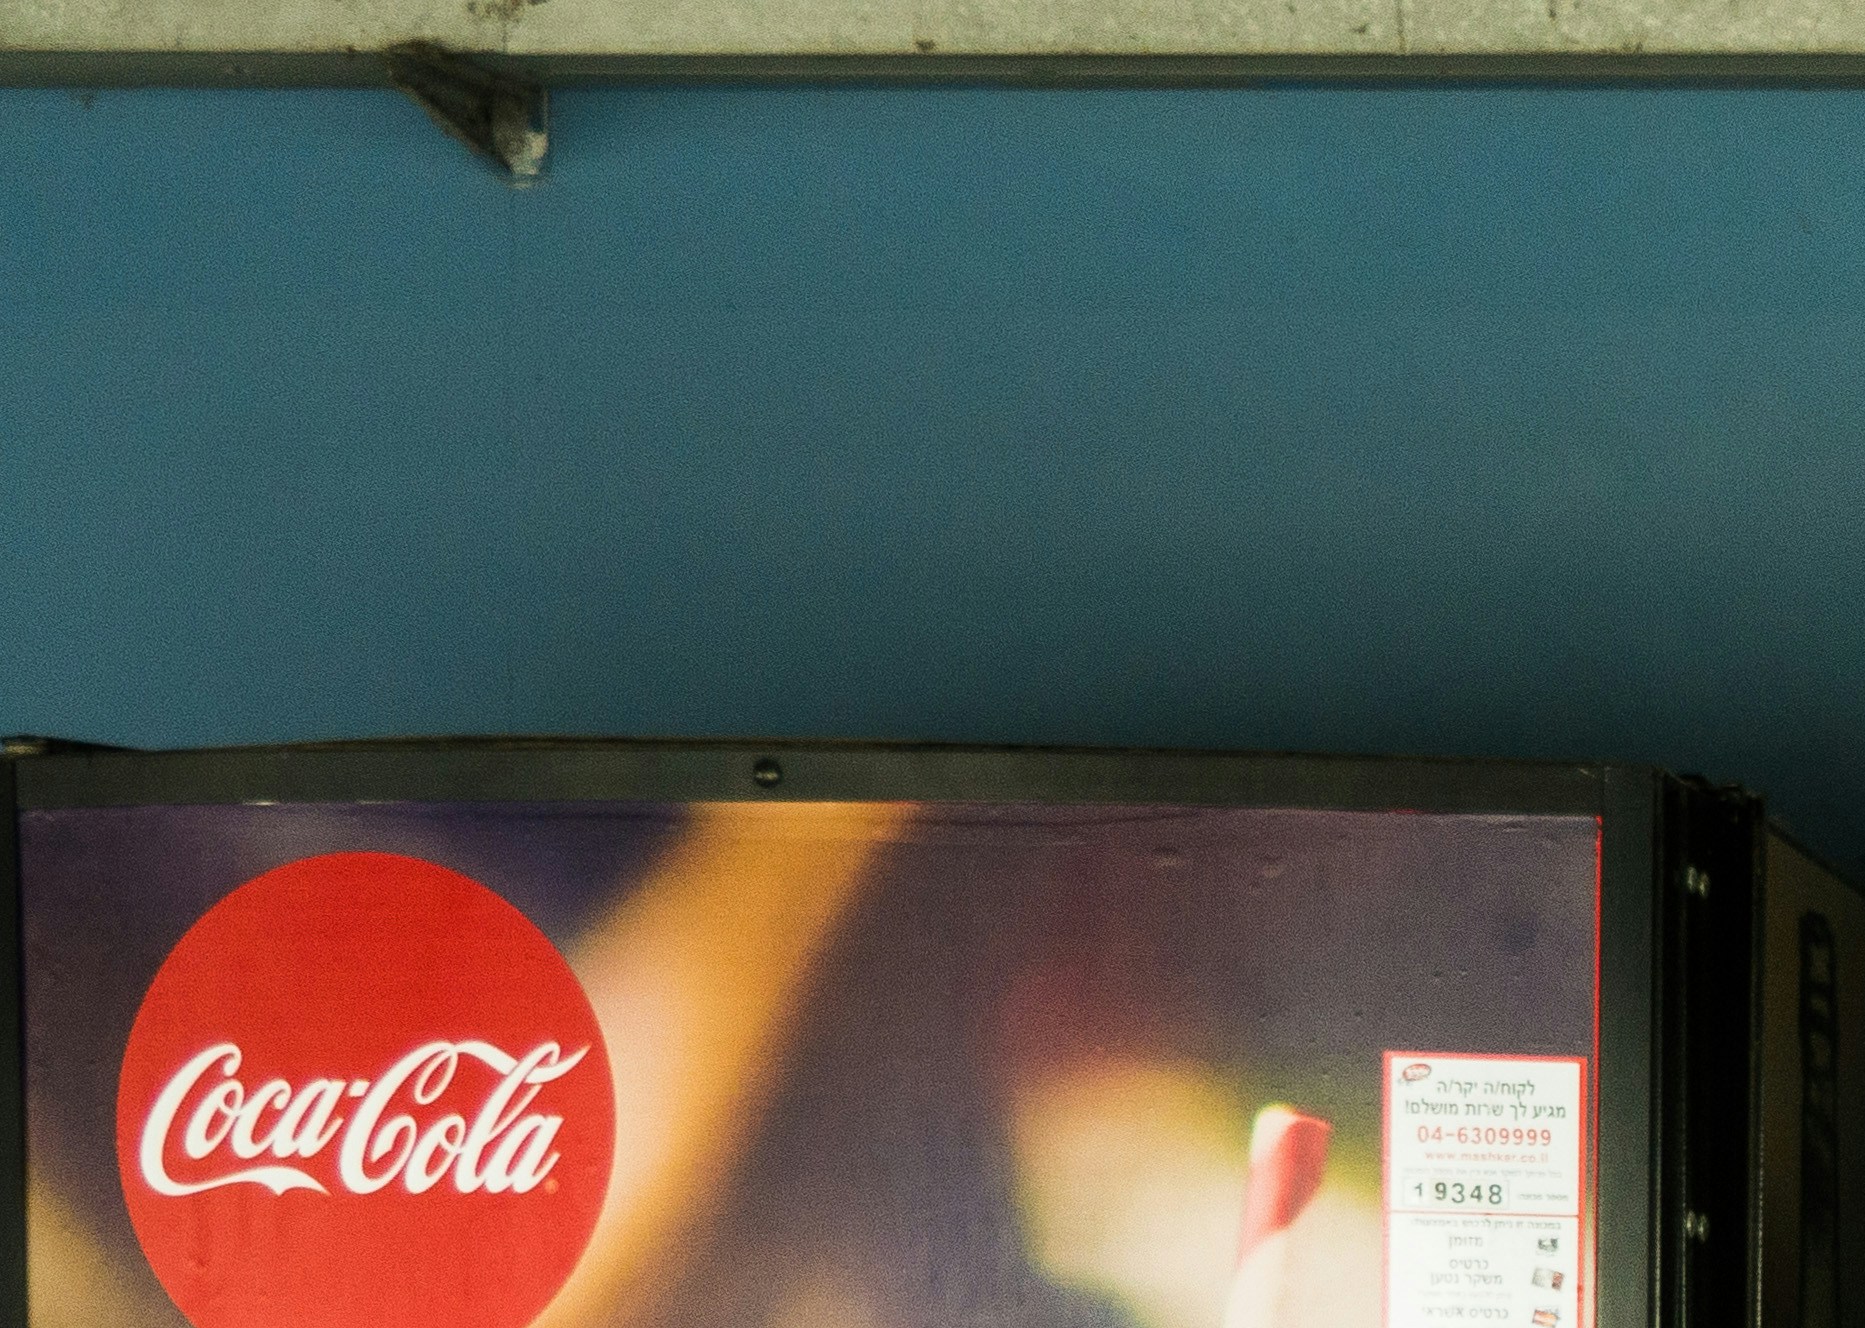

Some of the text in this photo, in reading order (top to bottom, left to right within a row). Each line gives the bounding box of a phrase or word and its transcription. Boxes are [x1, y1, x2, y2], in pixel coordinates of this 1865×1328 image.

[139, 1039, 591, 1197] Coca-Cola
[1465, 1103, 1504, 1117] שרות
[1510, 1101, 1526, 1120] לך
[1532, 1105, 1566, 1119] מגיע
[1417, 1125, 1552, 1146] 04-6309999
